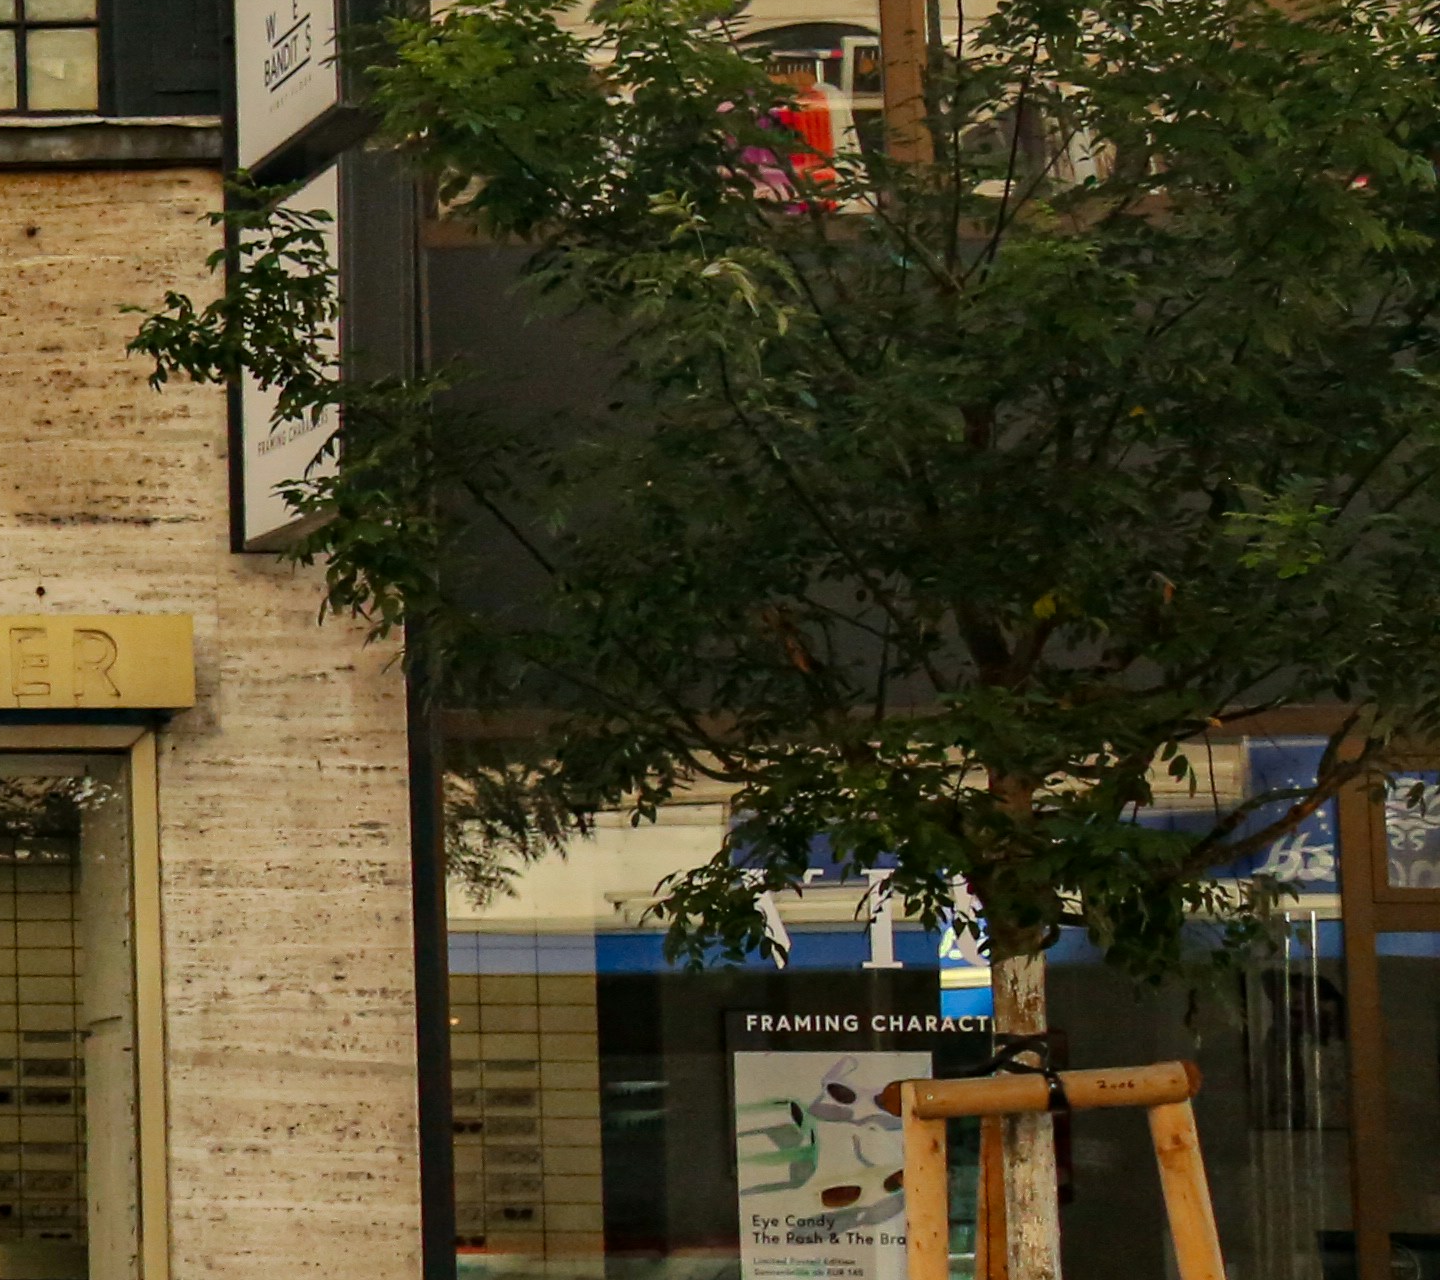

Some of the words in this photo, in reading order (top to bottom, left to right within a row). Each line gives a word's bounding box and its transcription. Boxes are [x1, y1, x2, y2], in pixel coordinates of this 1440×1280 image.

[746, 1015, 859, 1032] FRAMING
[752, 1215, 779, 1229] Eye
[785, 1215, 835, 1231] Candy
[752, 1232, 780, 1245] The
[829, 1233, 840, 1245] &
[846, 1232, 874, 1245] The
